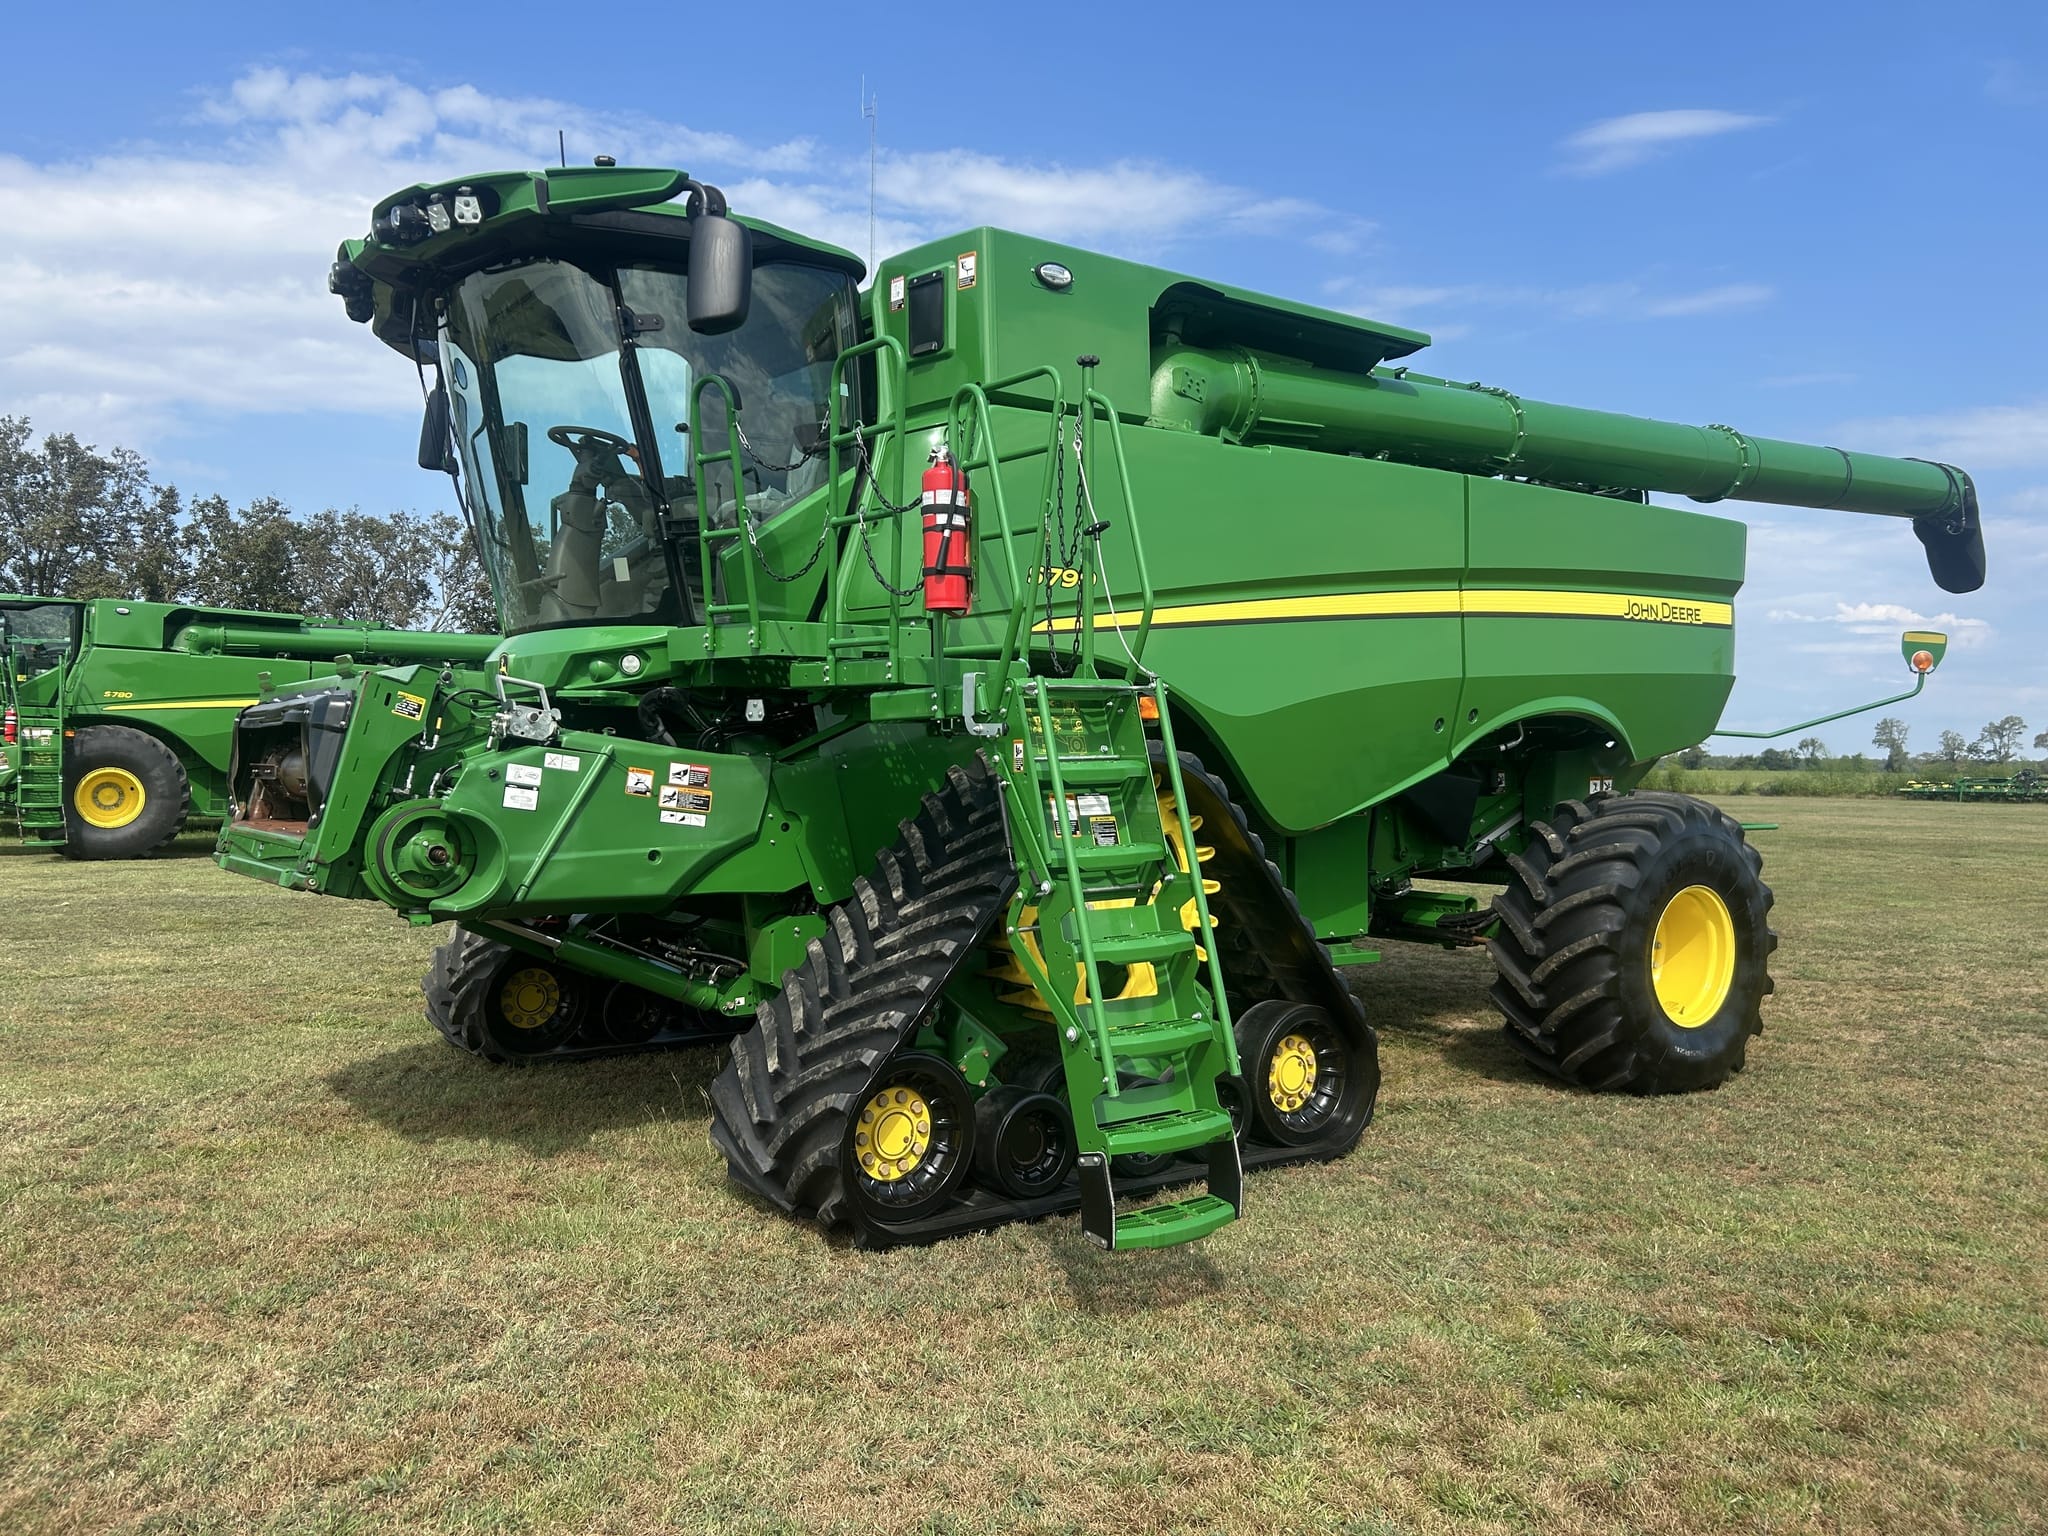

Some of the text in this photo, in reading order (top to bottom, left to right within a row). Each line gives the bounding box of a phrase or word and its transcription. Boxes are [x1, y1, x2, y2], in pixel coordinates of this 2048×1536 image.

[1624, 599, 1702, 622] JOHN DEERE
[103, 690, 133, 699] S780
